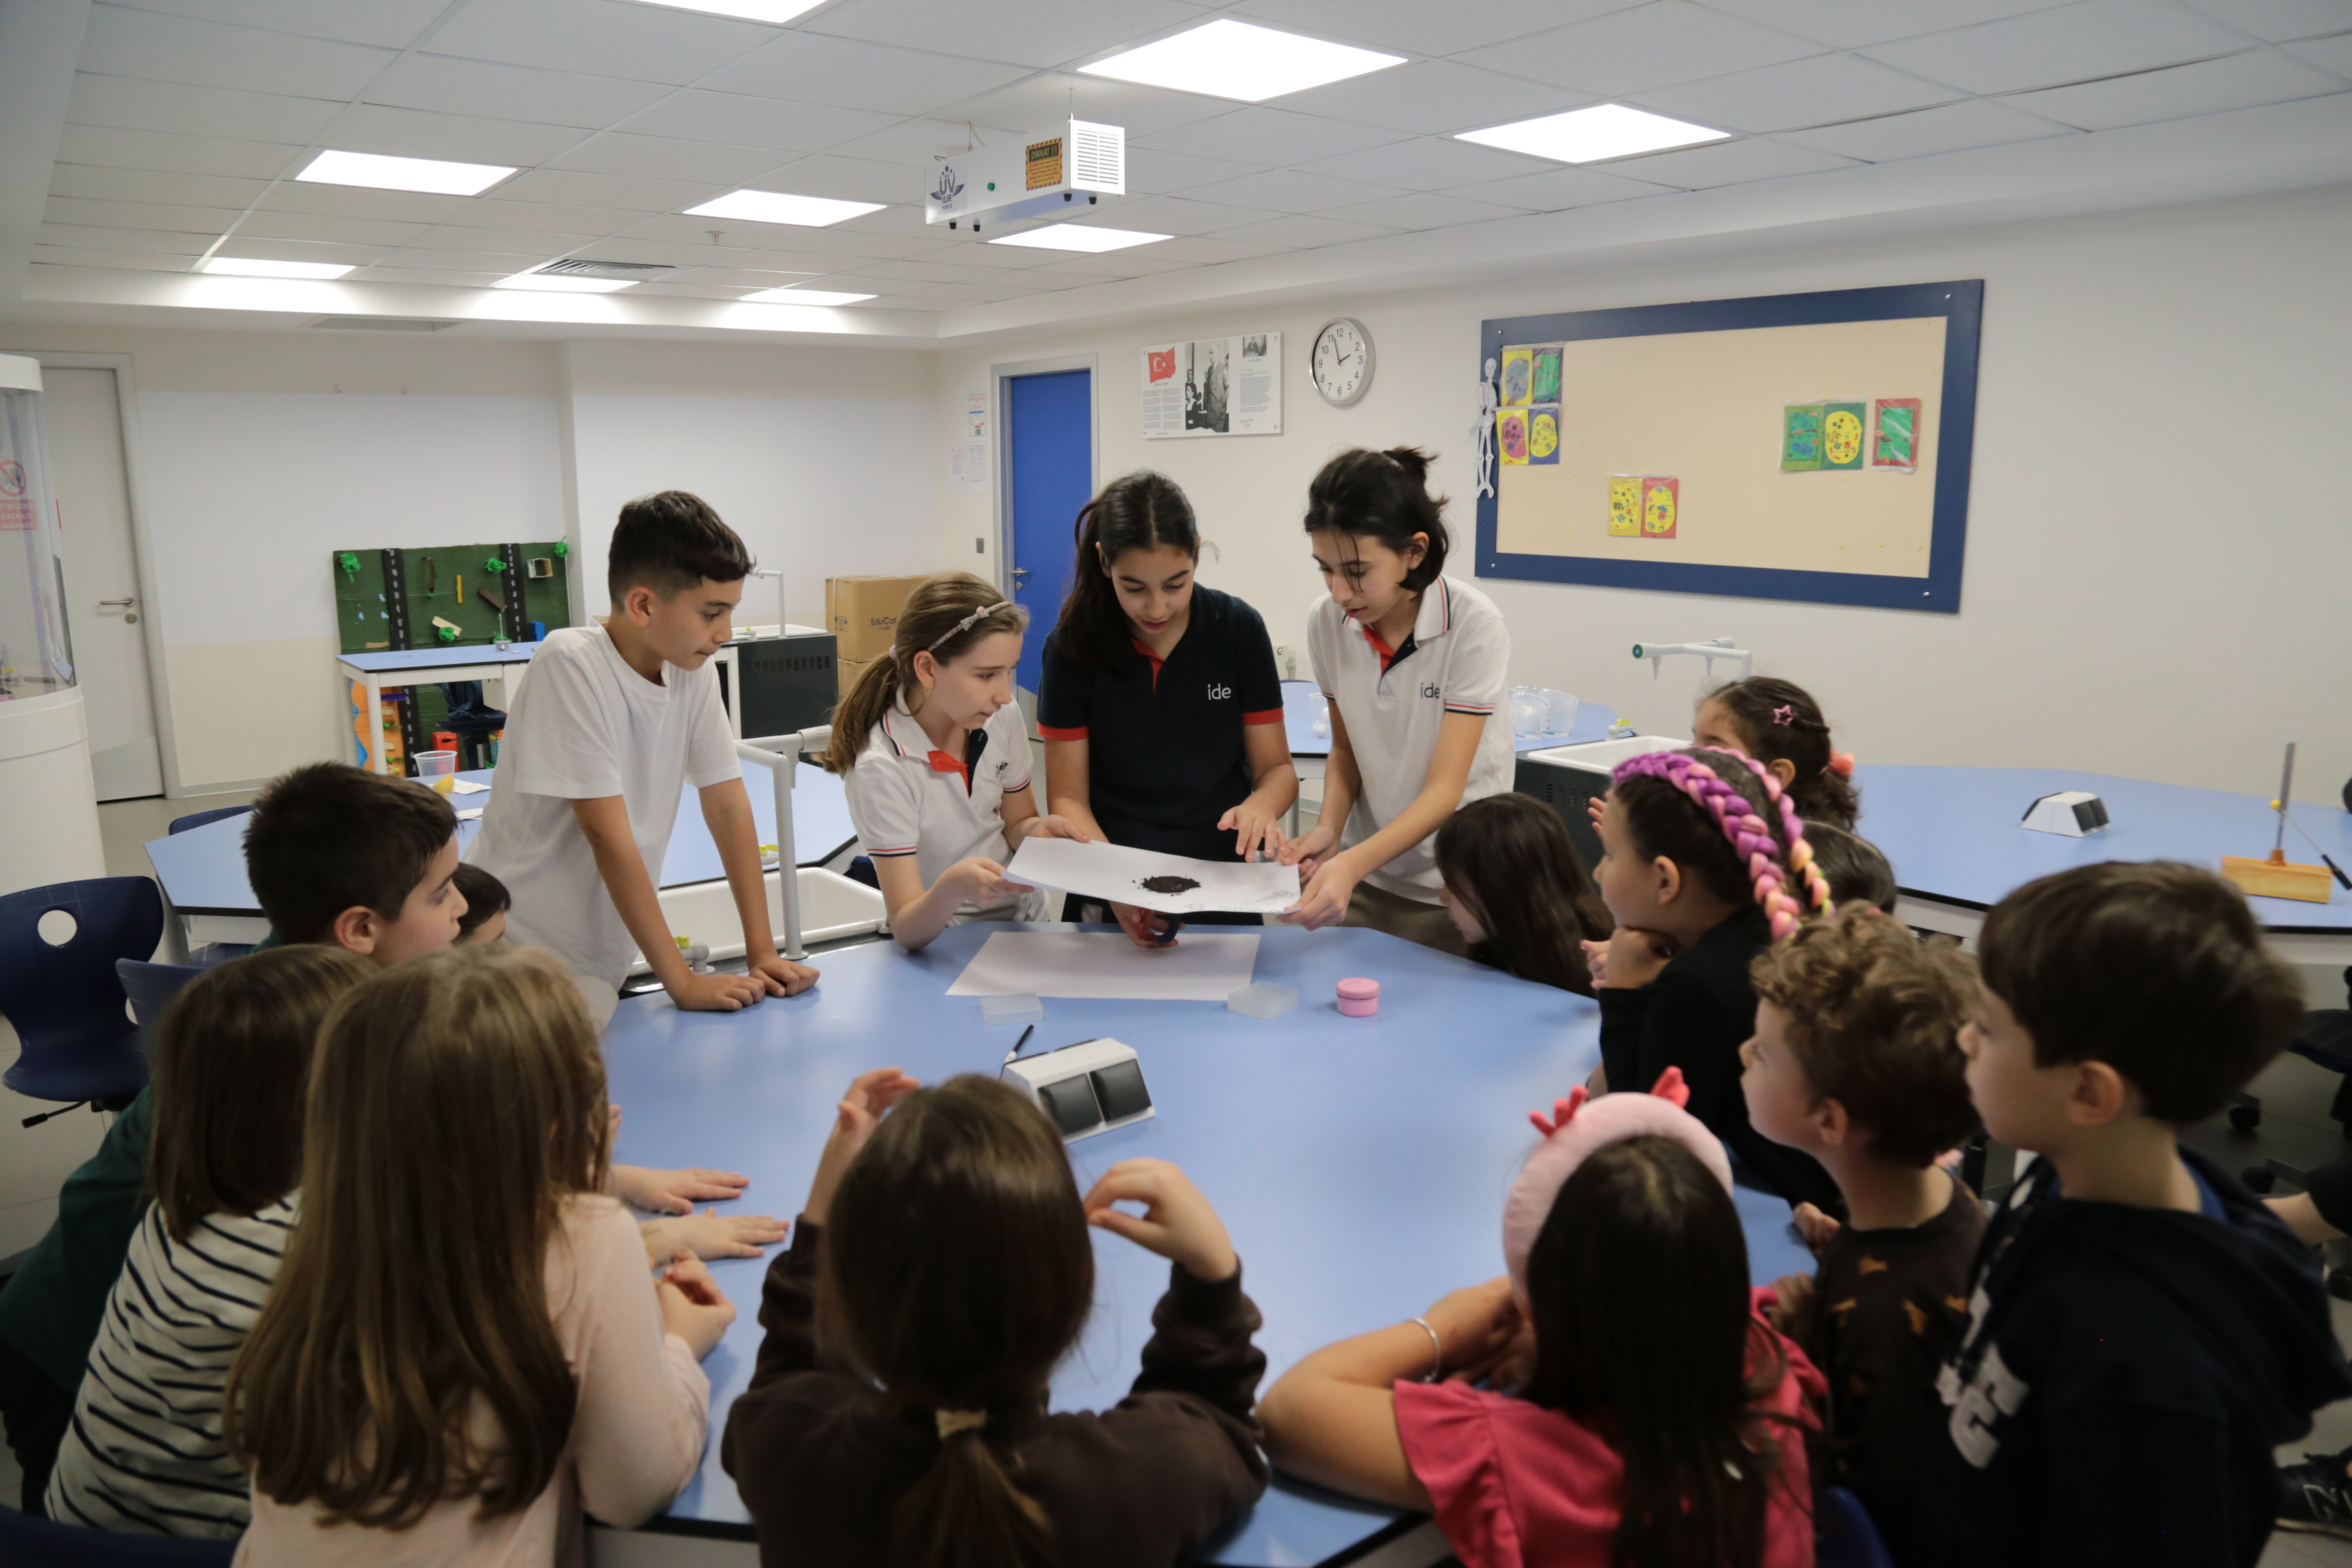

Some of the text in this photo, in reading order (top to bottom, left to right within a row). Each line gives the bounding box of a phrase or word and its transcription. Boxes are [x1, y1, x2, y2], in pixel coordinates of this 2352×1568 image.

[1032, 147, 1050, 159] DİKKAT
[940, 176, 956, 195] UV
[943, 194, 952, 204] AIR
[1336, 328, 1344, 337] 12
[1349, 332, 1351, 340] 1
[1328, 334, 1333, 343] 11
[1321, 345, 1329, 354] 10
[1355, 342, 1360, 351] 2
[1318, 359, 1323, 368] 9
[1358, 355, 1363, 364] 3
[1321, 374, 1325, 383] 8
[1354, 371, 1359, 380] 4
[1328, 383, 1332, 392] 7
[1348, 381, 1352, 390] 5
[1338, 386, 1342, 395] 6
[871, 617, 897, 625] EduCat
[1207, 683, 1231, 700] ide
[1421, 682, 1440, 698] ide
